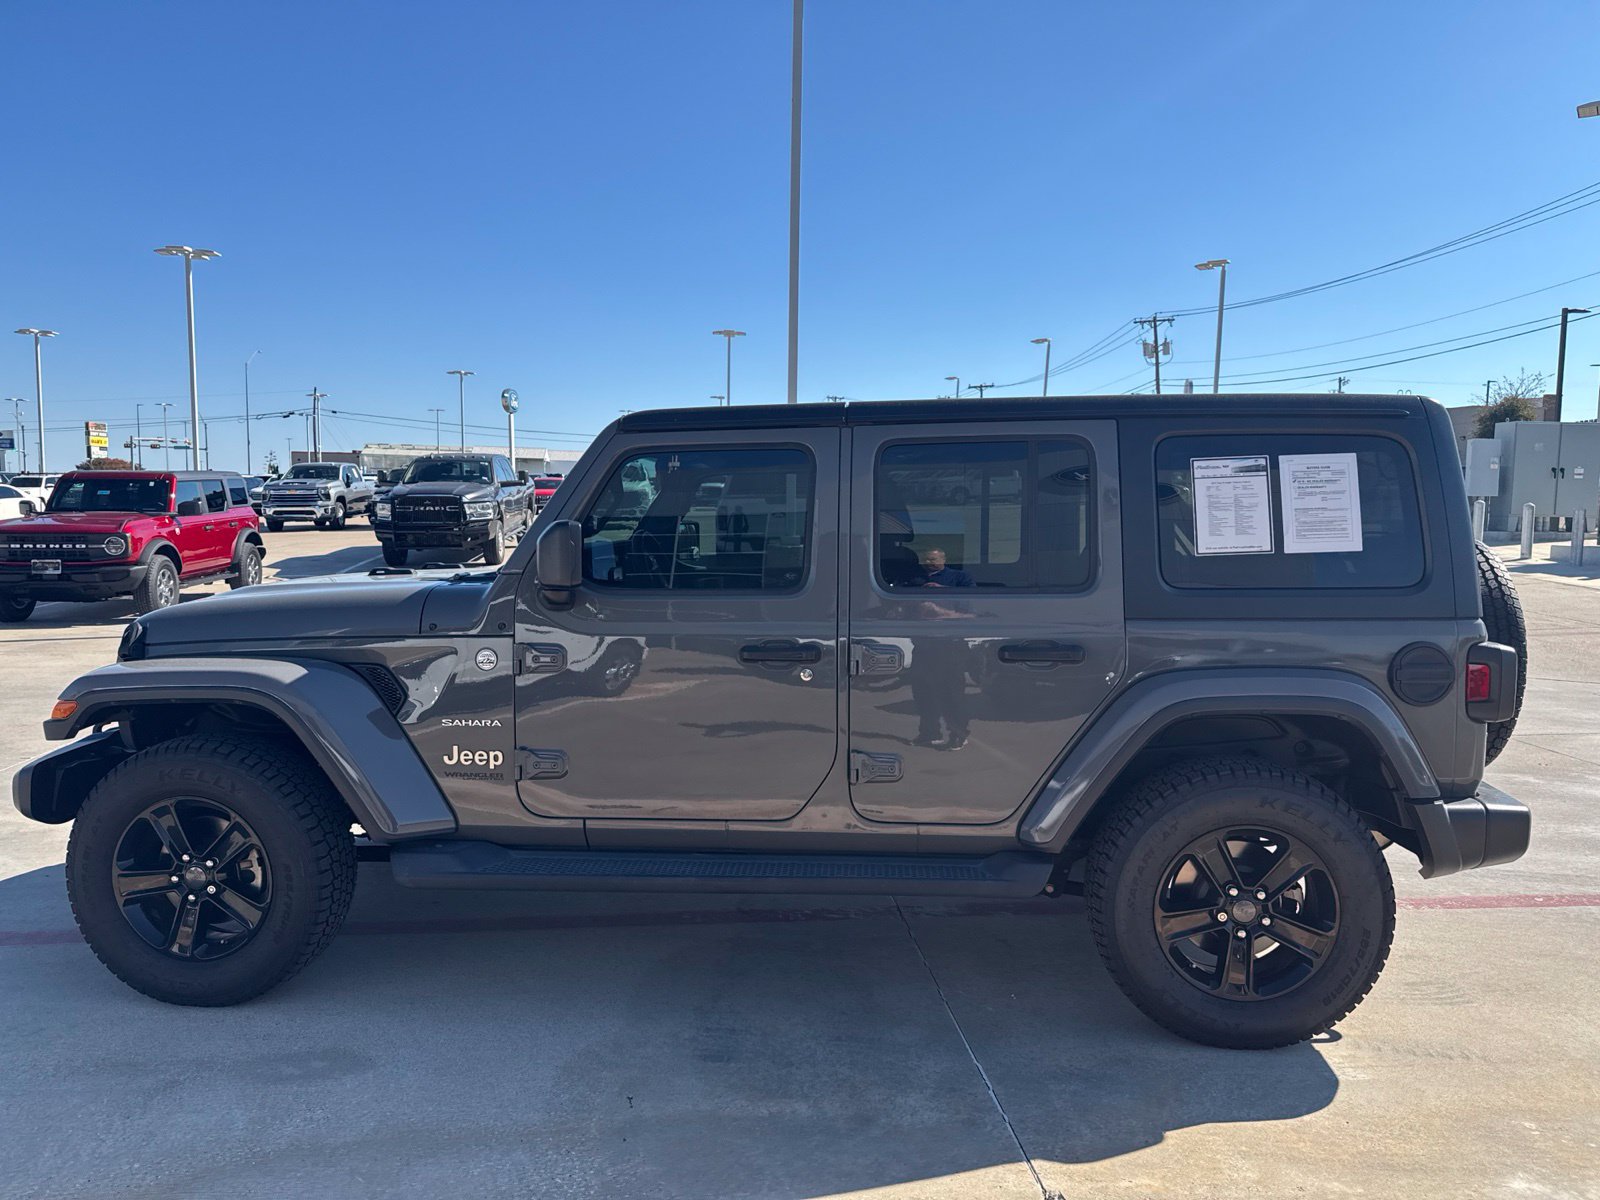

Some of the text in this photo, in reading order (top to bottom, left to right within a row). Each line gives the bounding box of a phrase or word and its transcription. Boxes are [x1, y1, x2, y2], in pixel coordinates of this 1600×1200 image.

[441, 719, 503, 727] SAHARA
[443, 745, 504, 769] Jeep
[158, 767, 245, 794] KELLY
[1258, 796, 1352, 846] KELLY
